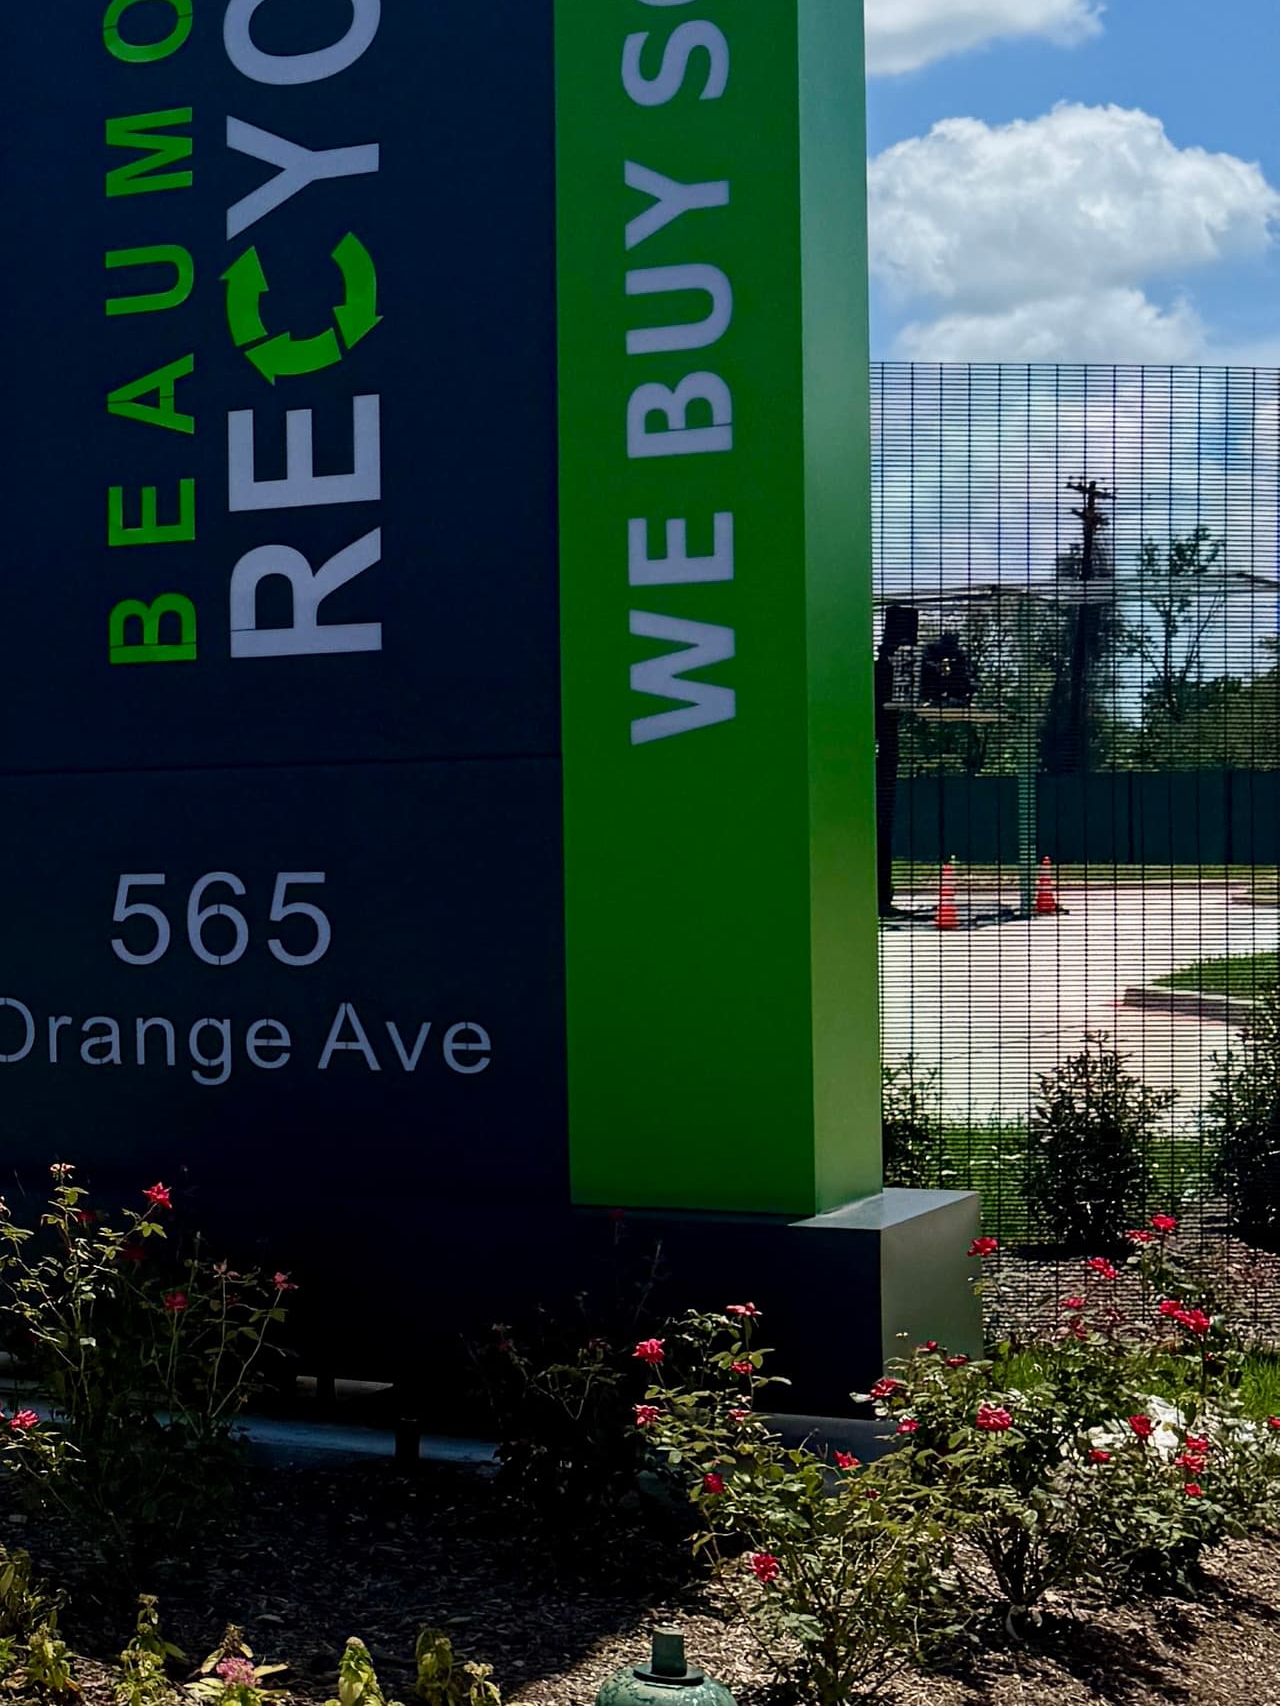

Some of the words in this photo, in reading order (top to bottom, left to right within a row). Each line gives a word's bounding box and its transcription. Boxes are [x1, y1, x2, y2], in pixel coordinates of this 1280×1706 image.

[625, 163, 732, 458] BUY
[628, 512, 734, 742] WE
[111, 871, 331, 966] 565
[317, 1002, 493, 1074] Ave
